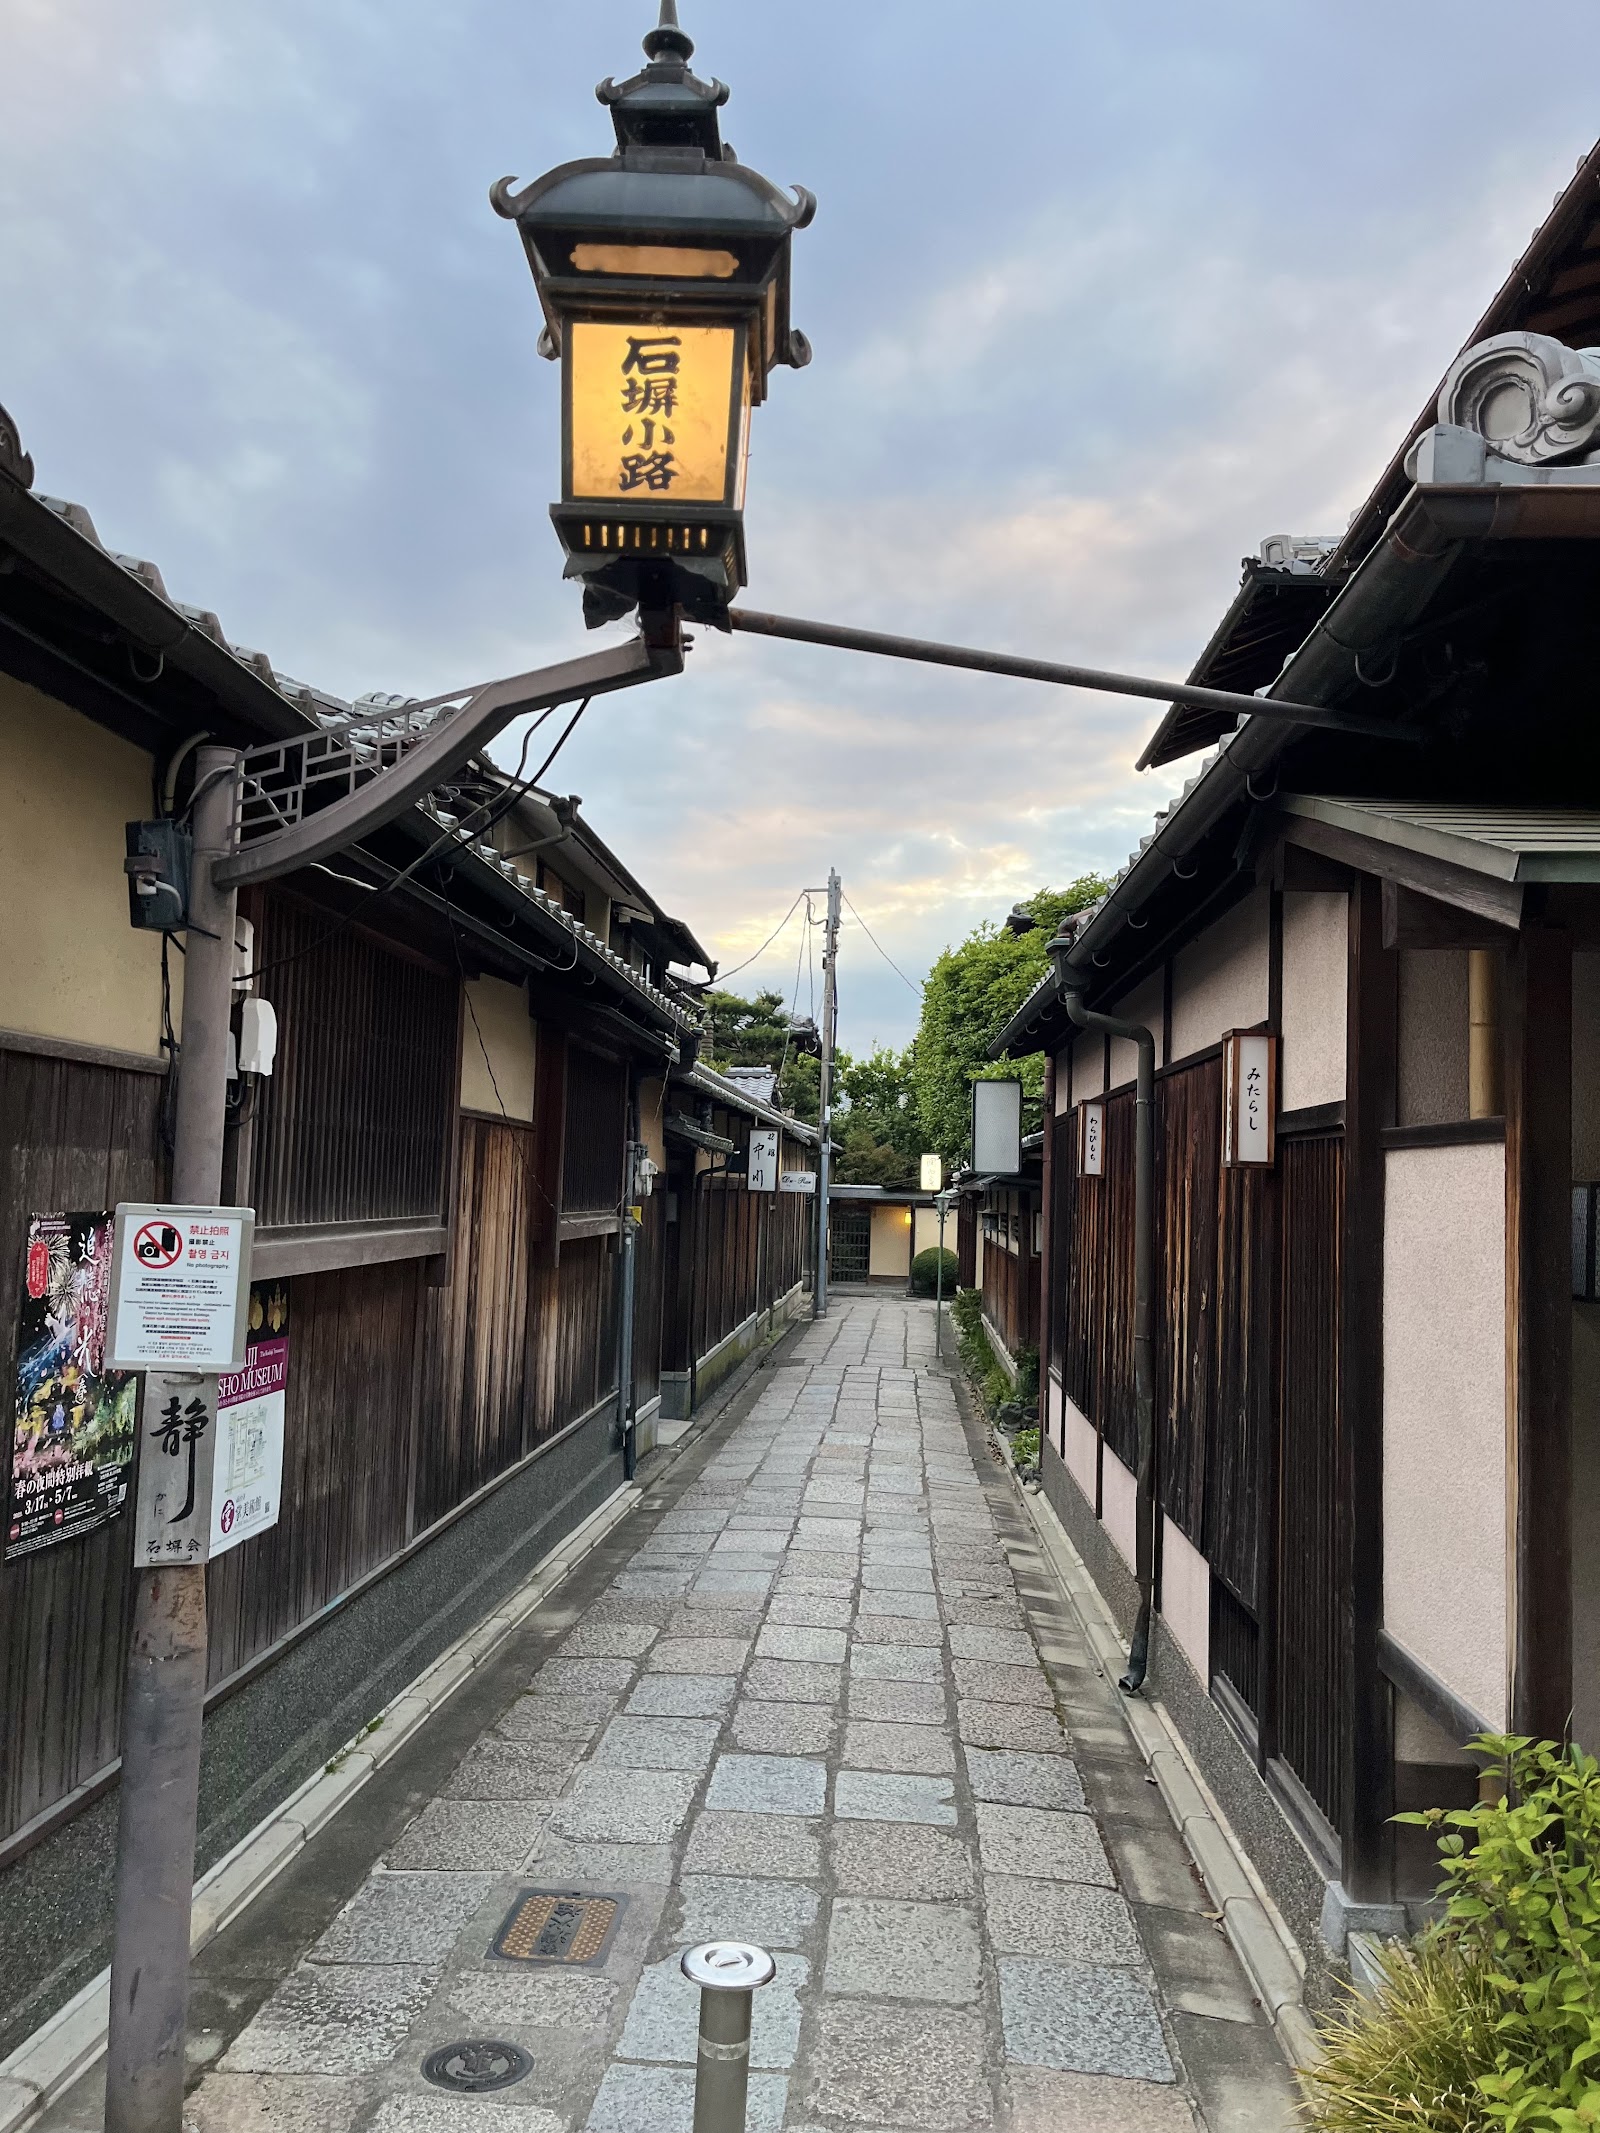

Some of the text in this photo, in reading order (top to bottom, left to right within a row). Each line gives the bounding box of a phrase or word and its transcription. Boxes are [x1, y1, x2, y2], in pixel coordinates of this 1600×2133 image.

[618, 335, 682, 492] 石塀小路
[1246, 1067, 1261, 1131] みたらし
[752, 1142, 765, 1189] 中川
[189, 1225, 230, 1236] 禁止拍照
[188, 1249, 230, 1260] 촬영 금지
[240, 1363, 284, 1392] MUSEUM
